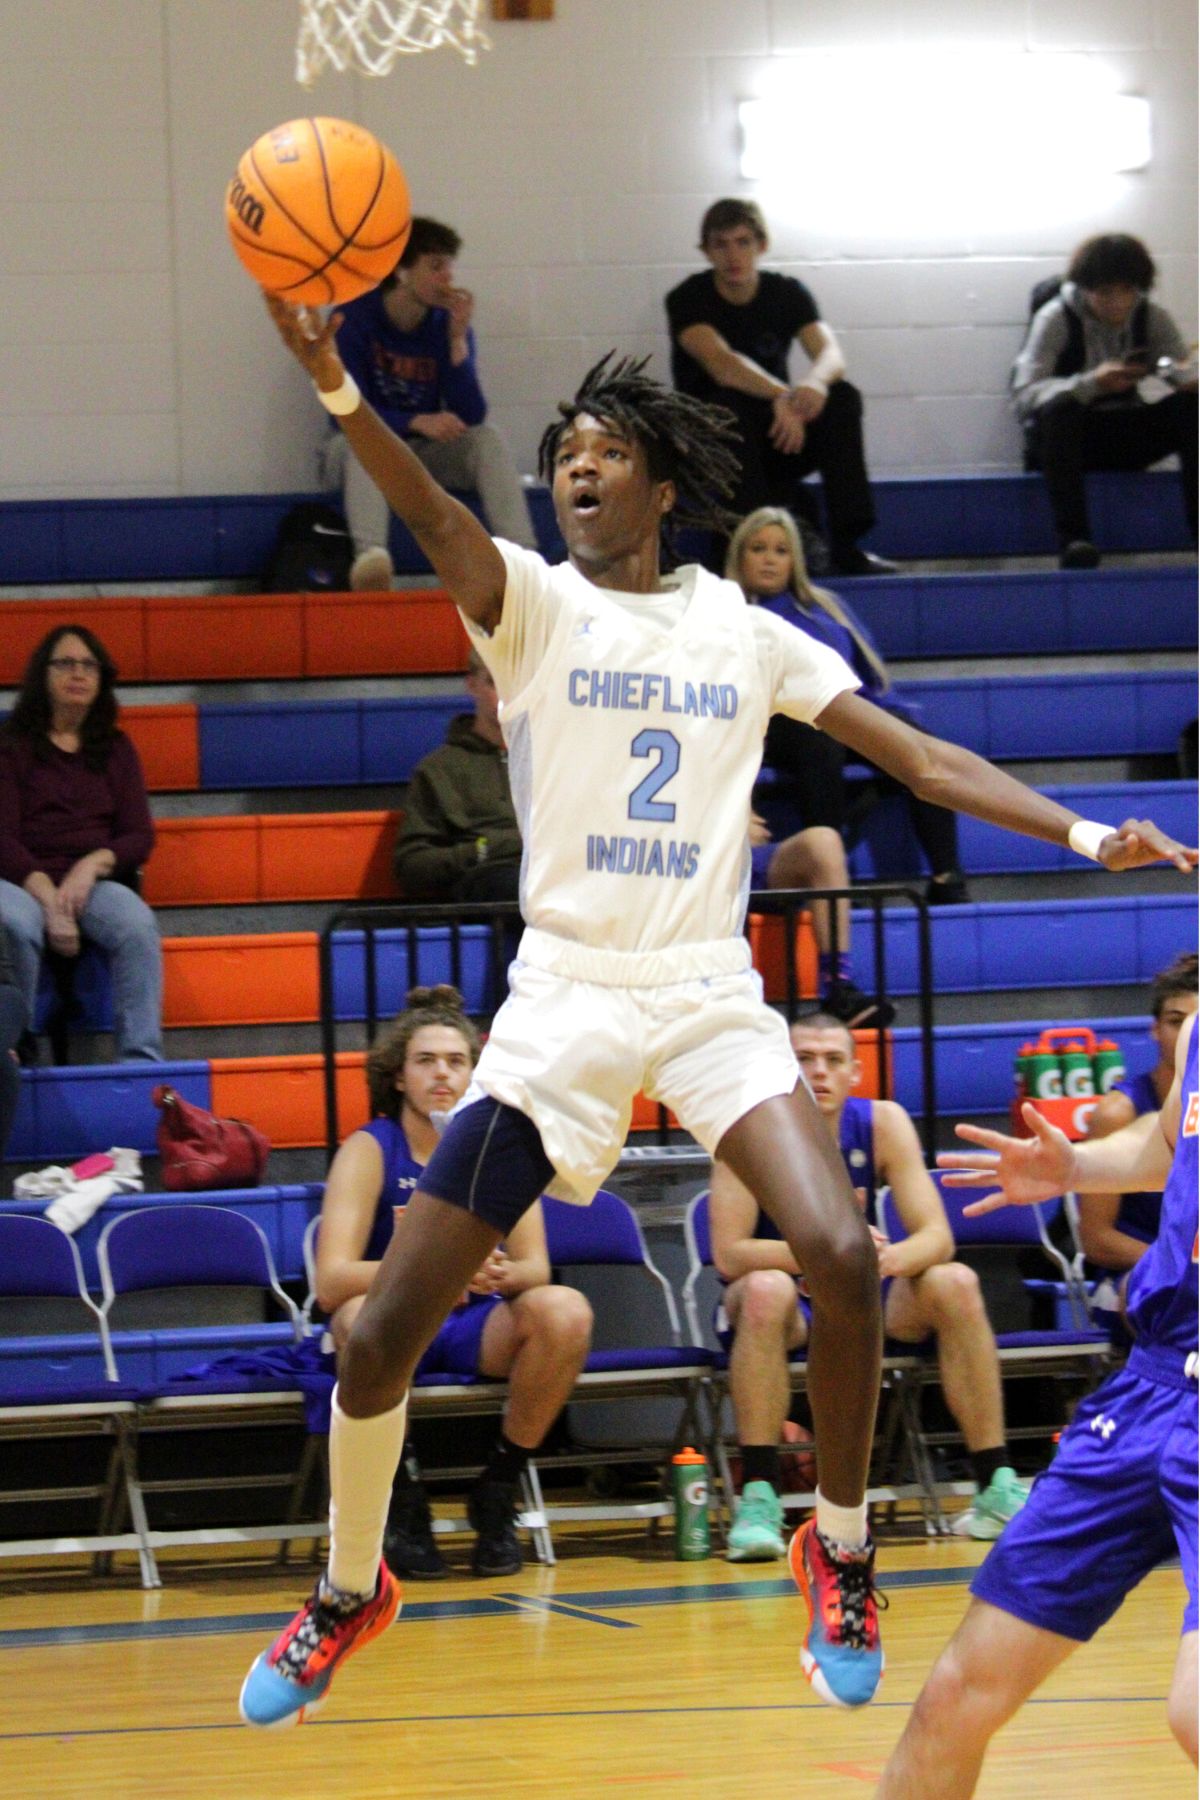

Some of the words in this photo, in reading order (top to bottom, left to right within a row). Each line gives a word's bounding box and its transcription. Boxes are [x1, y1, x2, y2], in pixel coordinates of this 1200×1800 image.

[568, 668, 739, 720] CHIEFLAND
[627, 728, 681, 823] 2
[587, 834, 701, 879] INDIANS
[1037, 1069, 1063, 1100] G
[1065, 1067, 1094, 1099] G
[685, 1481, 708, 1506] G
